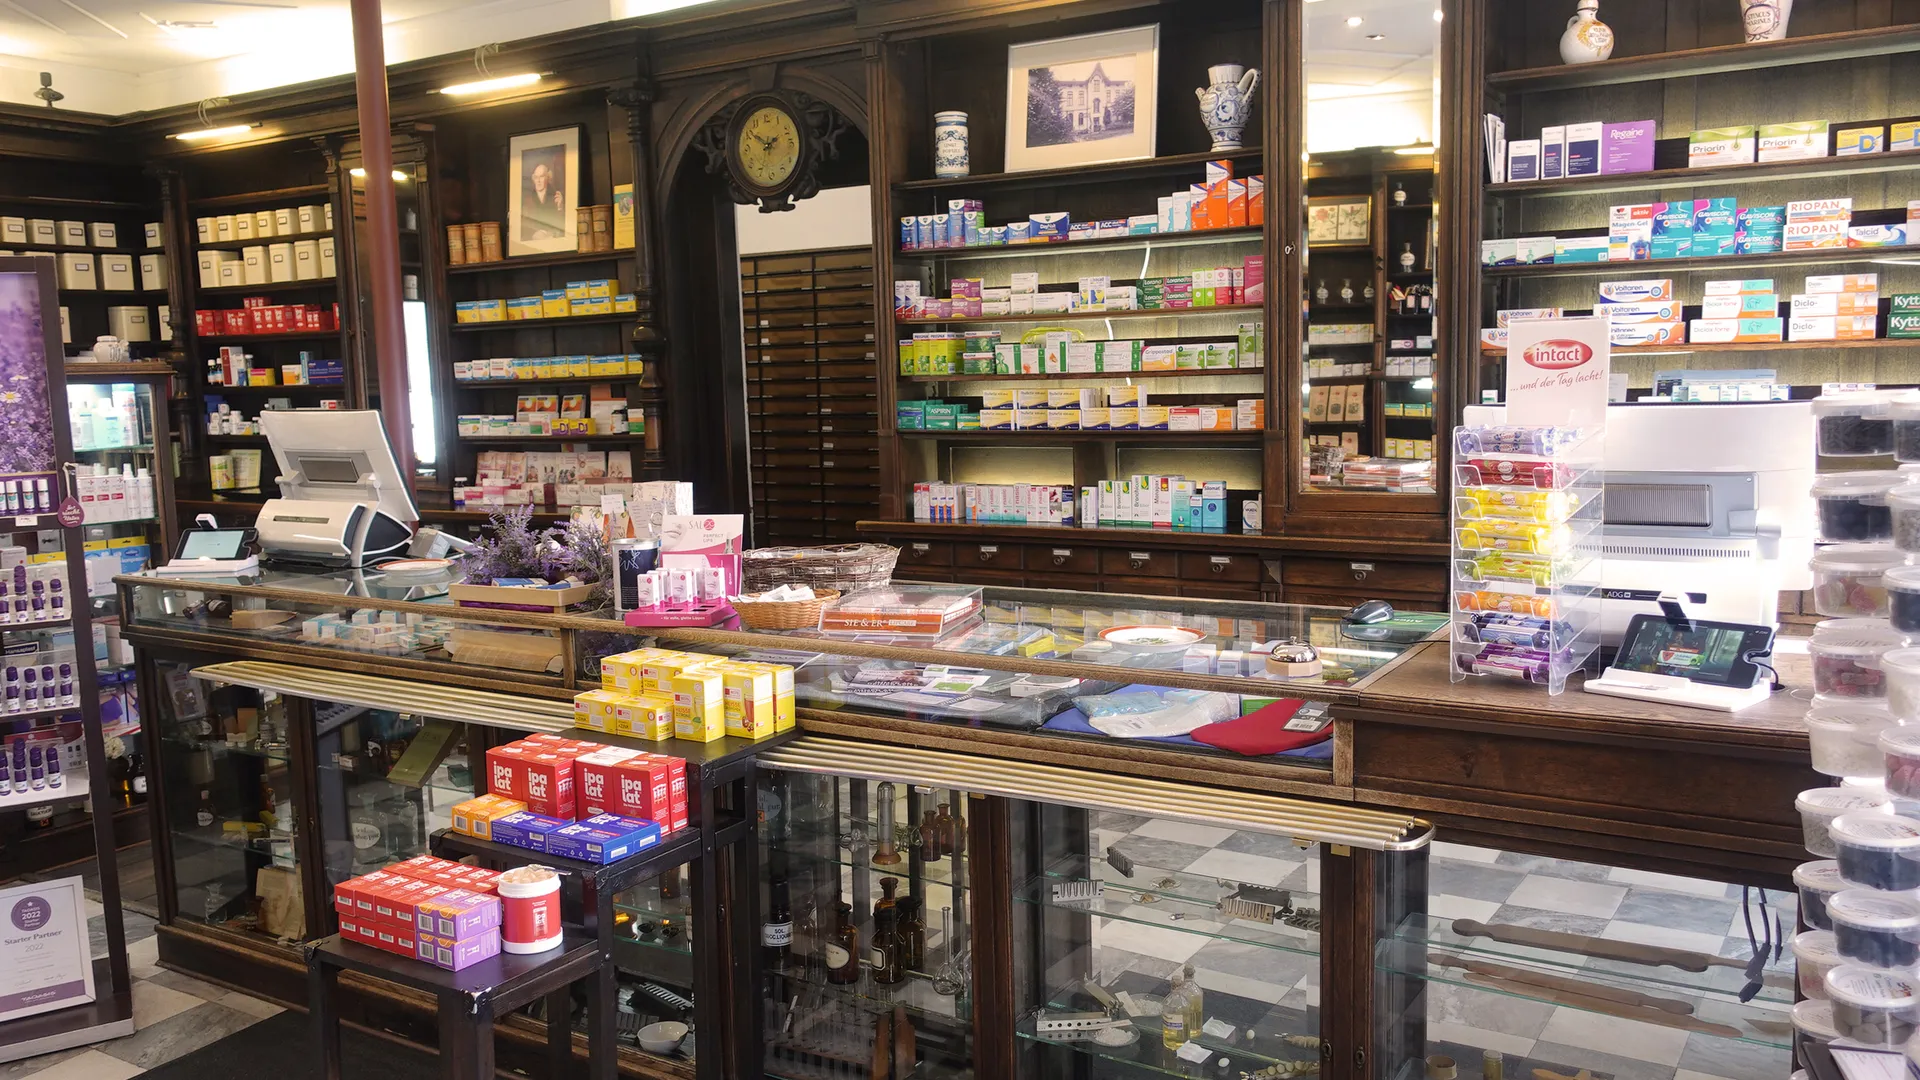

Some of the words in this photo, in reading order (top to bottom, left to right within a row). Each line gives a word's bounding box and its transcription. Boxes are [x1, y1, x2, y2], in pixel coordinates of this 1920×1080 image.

[1610, 128, 1645, 140] Regaine
[1692, 144, 1726, 154] Priorin
[1762, 138, 1797, 148] Priorin
[1791, 200, 1840, 212] RIOPAN
[1632, 209, 1649, 217] aktiv
[1698, 210, 1731, 218] GAVISCON
[1739, 211, 1776, 220] GAVISCON
[1612, 220, 1649, 228] Magen-Gel
[1787, 224, 1839, 235] RIOPAN
[1855, 228, 1879, 237] Talcid
[1145, 348, 1174, 356] Grippostad
[1535, 347, 1580, 362] intact
[1539, 378, 1556, 388] der
[1556, 371, 1574, 389] Tag
[1575, 369, 1604, 382] lacht!
[860, 618, 869, 627] &
[493, 760, 512, 779] ipa
[494, 774, 511, 791] lat
[528, 767, 547, 786] ipa
[584, 767, 604, 786] ipa
[528, 781, 547, 798] lat
[621, 774, 642, 793] ipa
[585, 782, 603, 798] lat
[622, 788, 641, 805] lat
[21, 910, 41, 921] 2022
[4, 935, 32, 945] Starter
[33, 930, 63, 941] Partner
[25, 942, 45, 953] 2022
